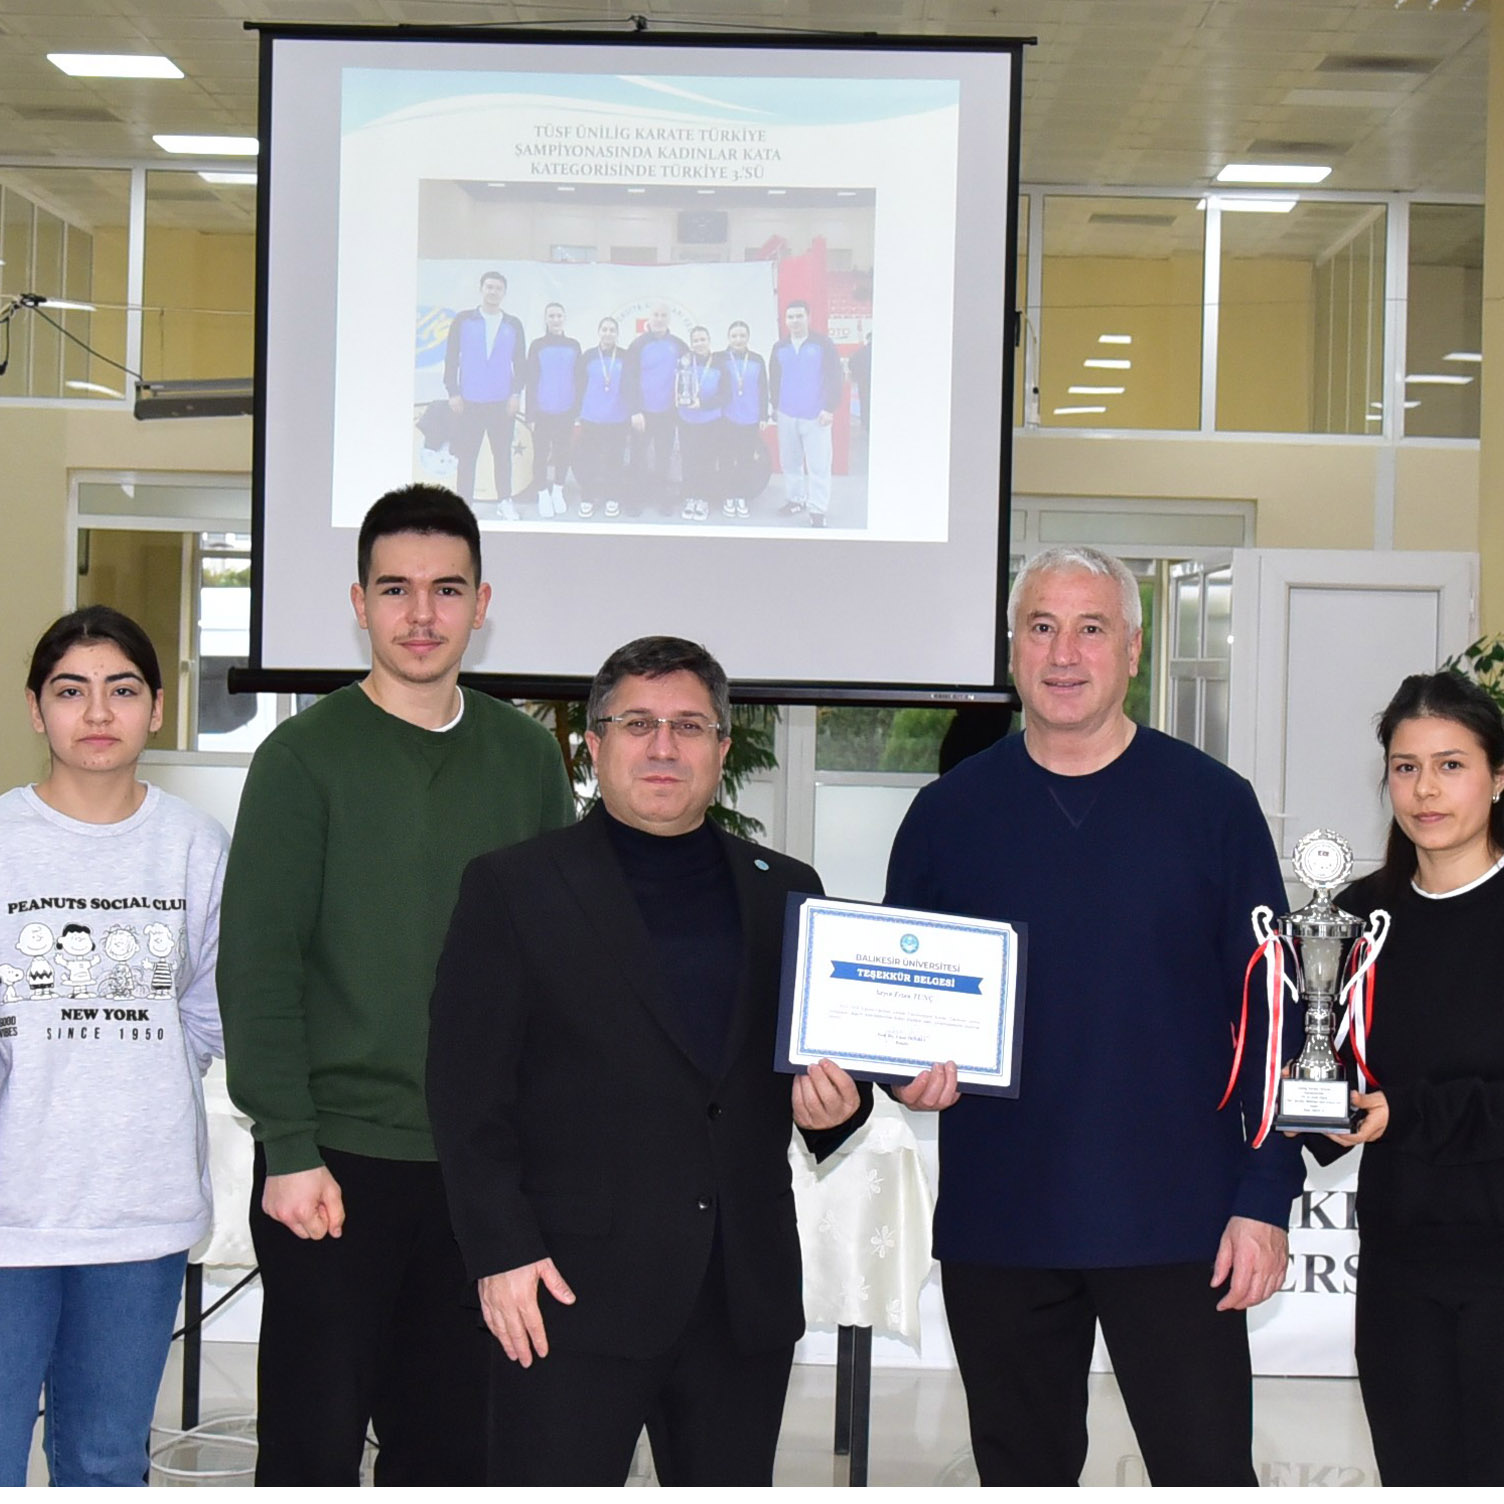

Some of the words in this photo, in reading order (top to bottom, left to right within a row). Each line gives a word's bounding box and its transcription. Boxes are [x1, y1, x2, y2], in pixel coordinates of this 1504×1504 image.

[535, 123, 572, 138] TÜSF
[636, 127, 694, 141] KARATE
[698, 128, 767, 142] TÜRKİYE
[658, 147, 737, 160] KADINLAR
[744, 148, 781, 160] KATA
[660, 164, 728, 178] TÜRKİYE
[8, 898, 86, 914] PEANUTS
[91, 897, 150, 910] SOCIAL
[153, 899, 186, 910] CLU
[856, 954, 900, 965] BALIKESİR
[857, 968, 911, 982] TEŞEKKÜR
[914, 976, 955, 987] BELGESİ
[61, 1009, 98, 1021] NEW
[103, 1009, 149, 1021] YORK
[0, 1017, 16, 1027] GOOD
[0, 1027, 18, 1037] VIBES
[47, 1027, 100, 1040] SINCE
[119, 1028, 164, 1040] 1950
